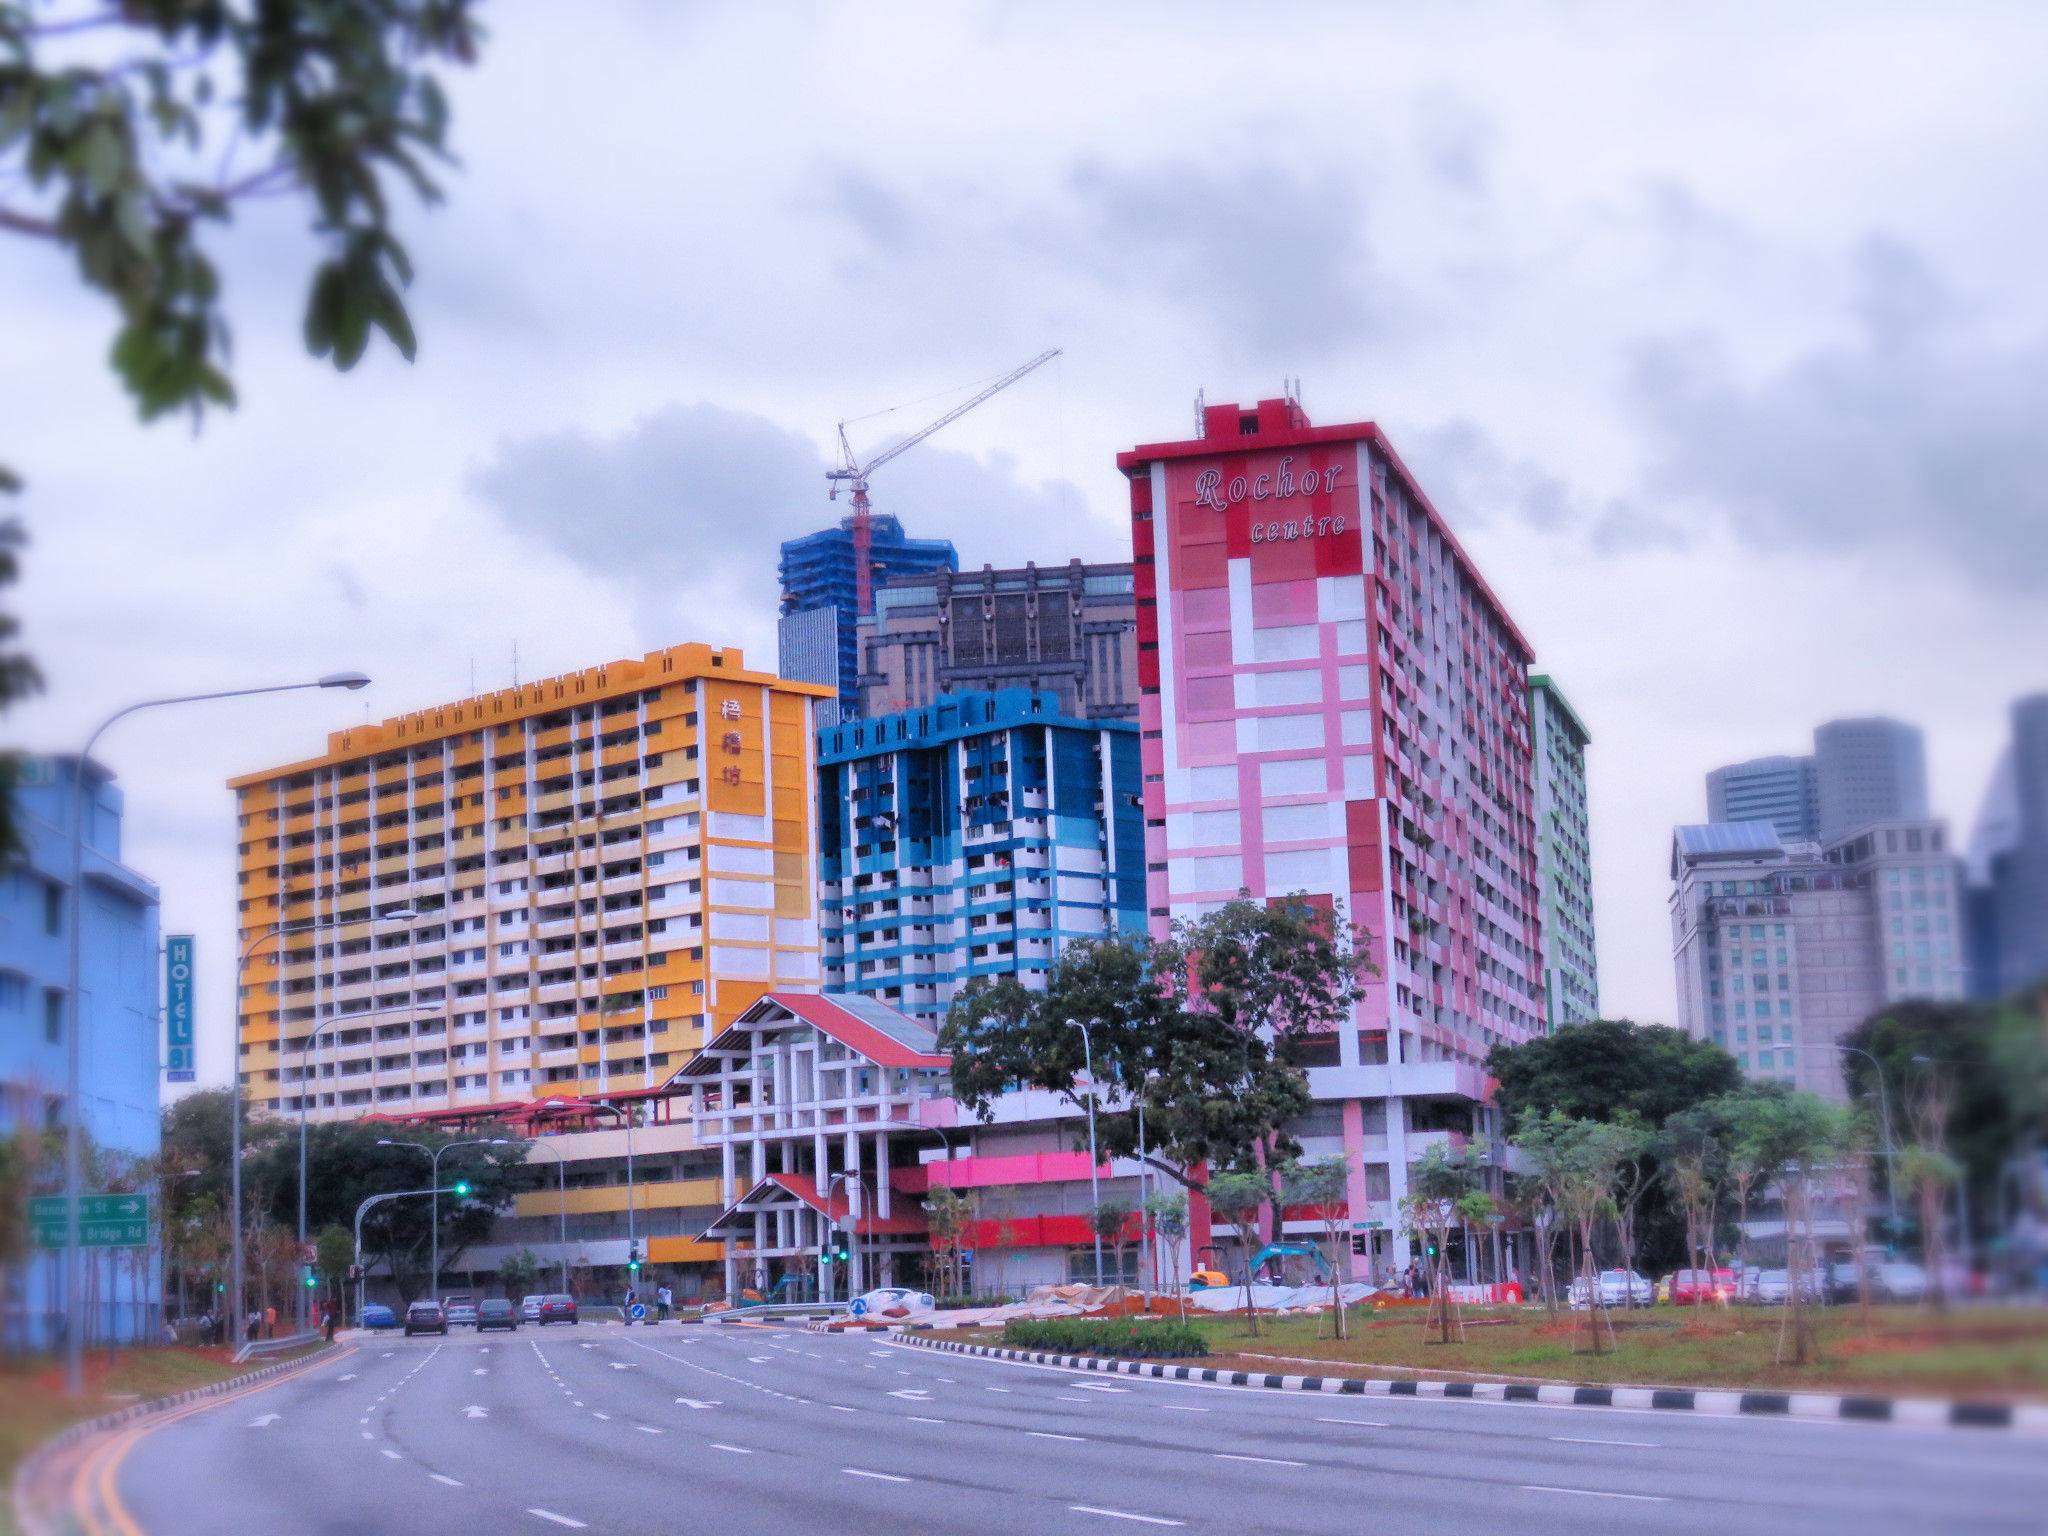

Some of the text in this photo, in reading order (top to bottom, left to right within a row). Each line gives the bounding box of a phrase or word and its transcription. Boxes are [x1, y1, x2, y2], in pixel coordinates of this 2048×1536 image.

[1195, 456, 1343, 512] Rochor
[1251, 514, 1345, 544] centre
[172, 944, 189, 1038] HOTEL
[169, 1048, 193, 1070] 81
[95, 1201, 107, 1214] St
[87, 1227, 122, 1242] Bridge
[128, 1225, 142, 1238] Rd
